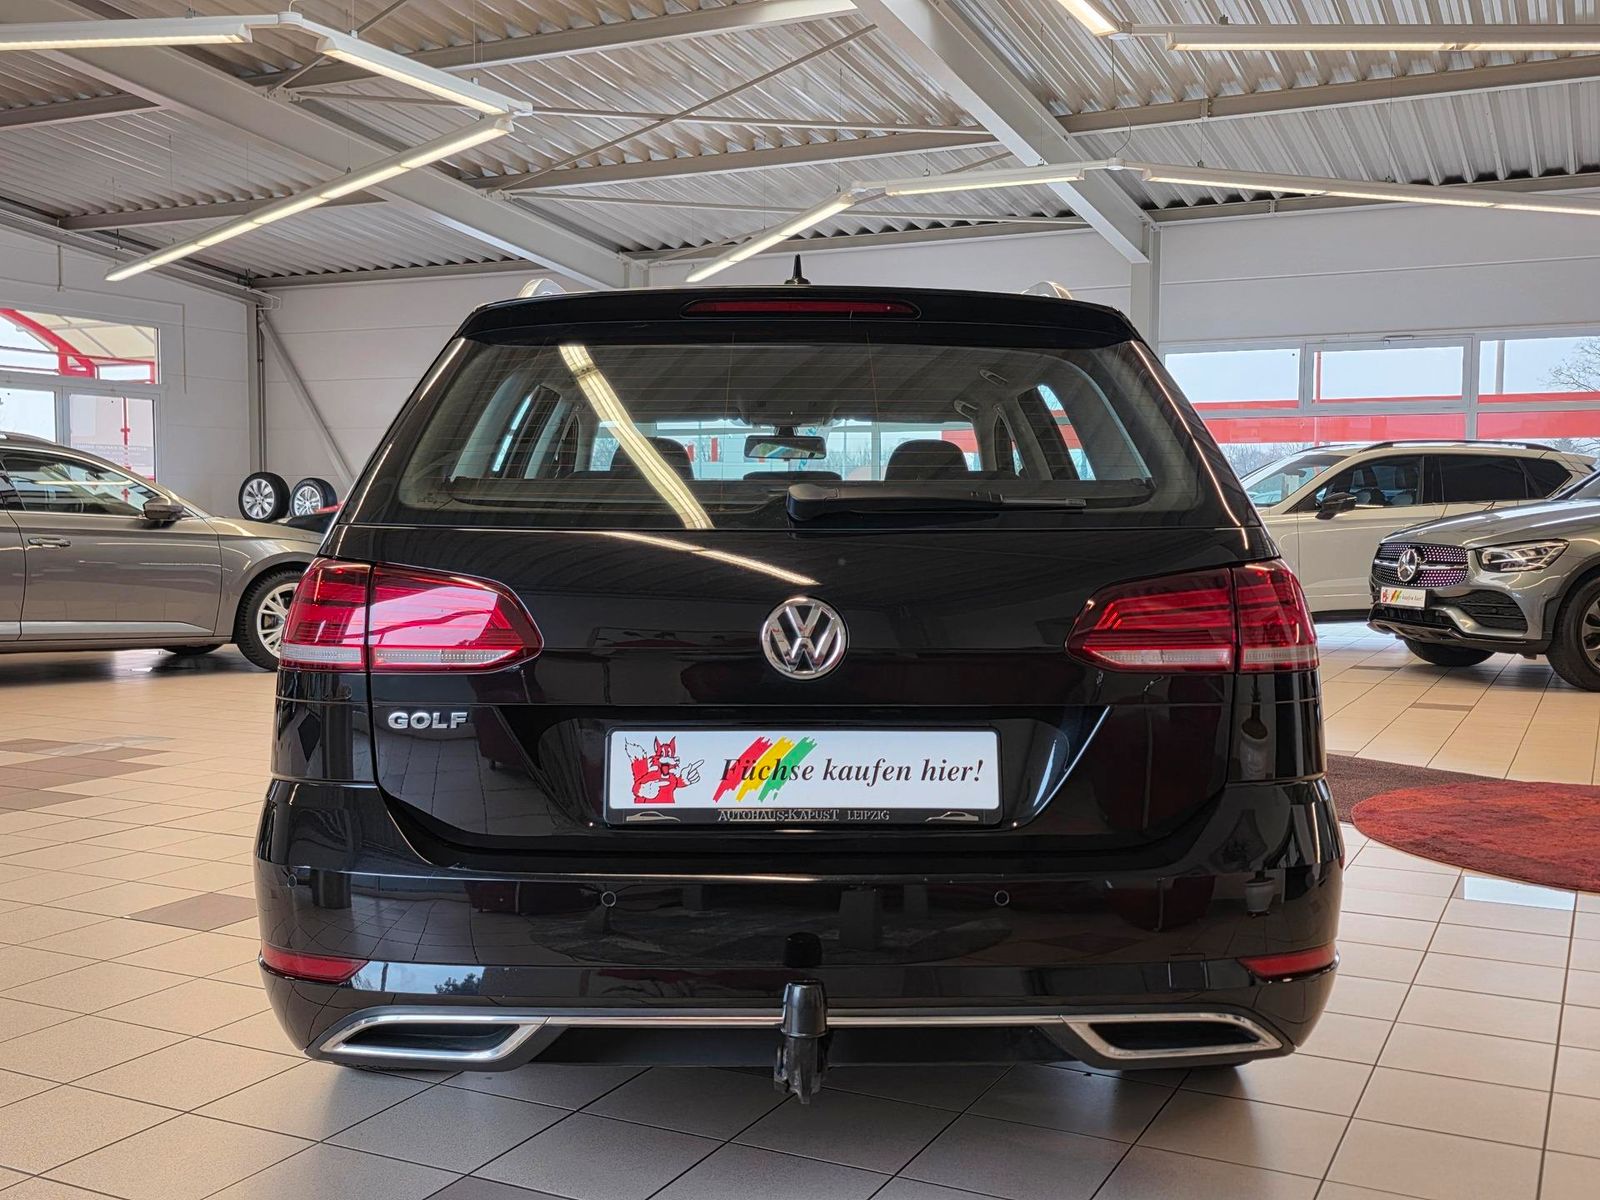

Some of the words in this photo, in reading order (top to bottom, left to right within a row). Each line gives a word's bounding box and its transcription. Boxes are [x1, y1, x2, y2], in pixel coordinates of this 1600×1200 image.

[765, 600, 845, 677] VW
[388, 711, 468, 729] GOLF
[720, 758, 815, 782] Füchse
[822, 757, 912, 787] kaufen
[920, 758, 984, 782] hier!
[847, 809, 890, 821] LEIPZIG
